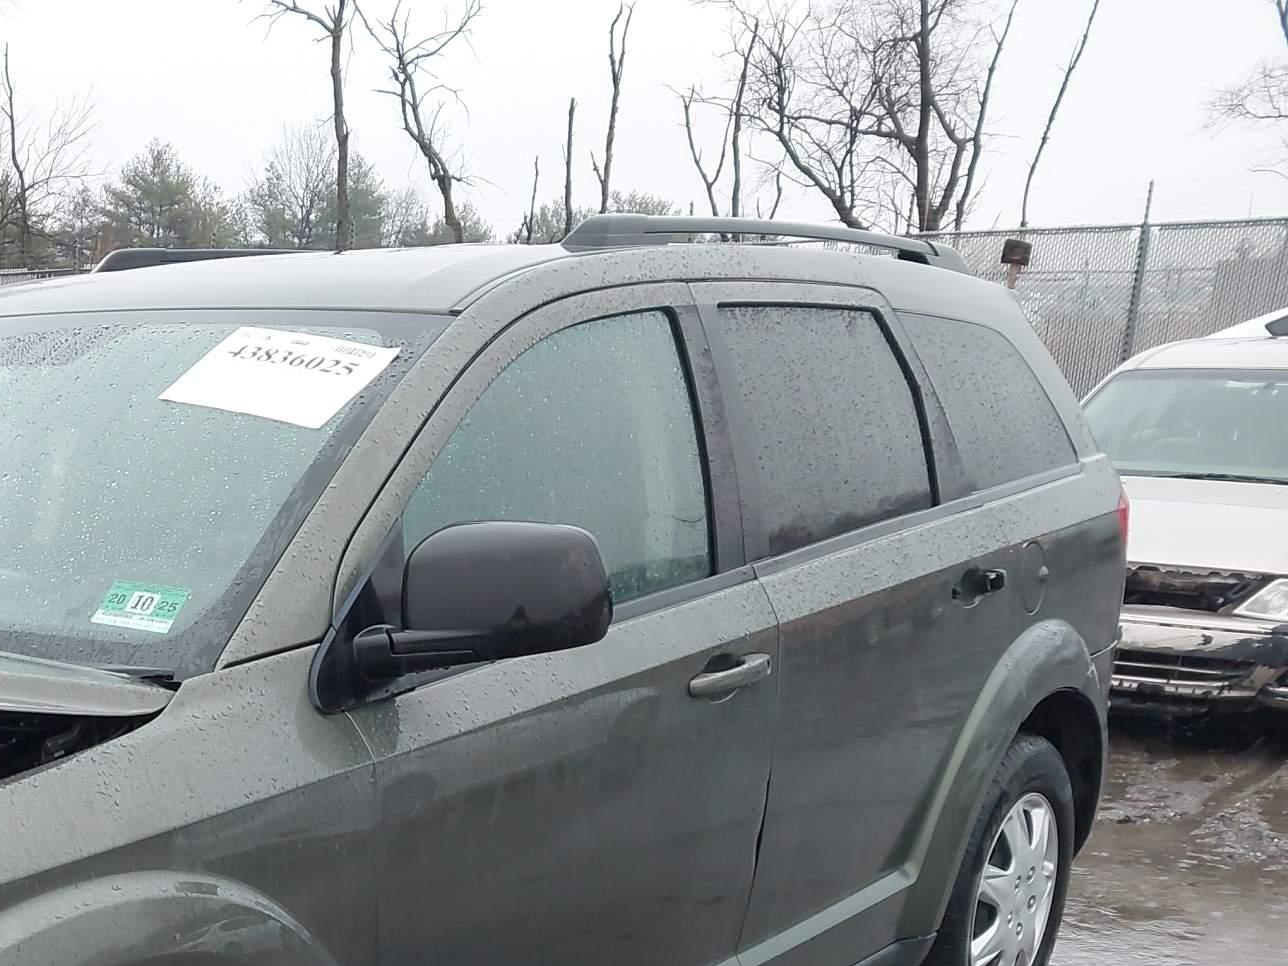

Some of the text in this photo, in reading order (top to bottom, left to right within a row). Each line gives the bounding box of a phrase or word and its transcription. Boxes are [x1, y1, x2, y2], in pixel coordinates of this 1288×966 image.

[229, 344, 360, 376] 43836025
[108, 592, 178, 612] 20 10 25
